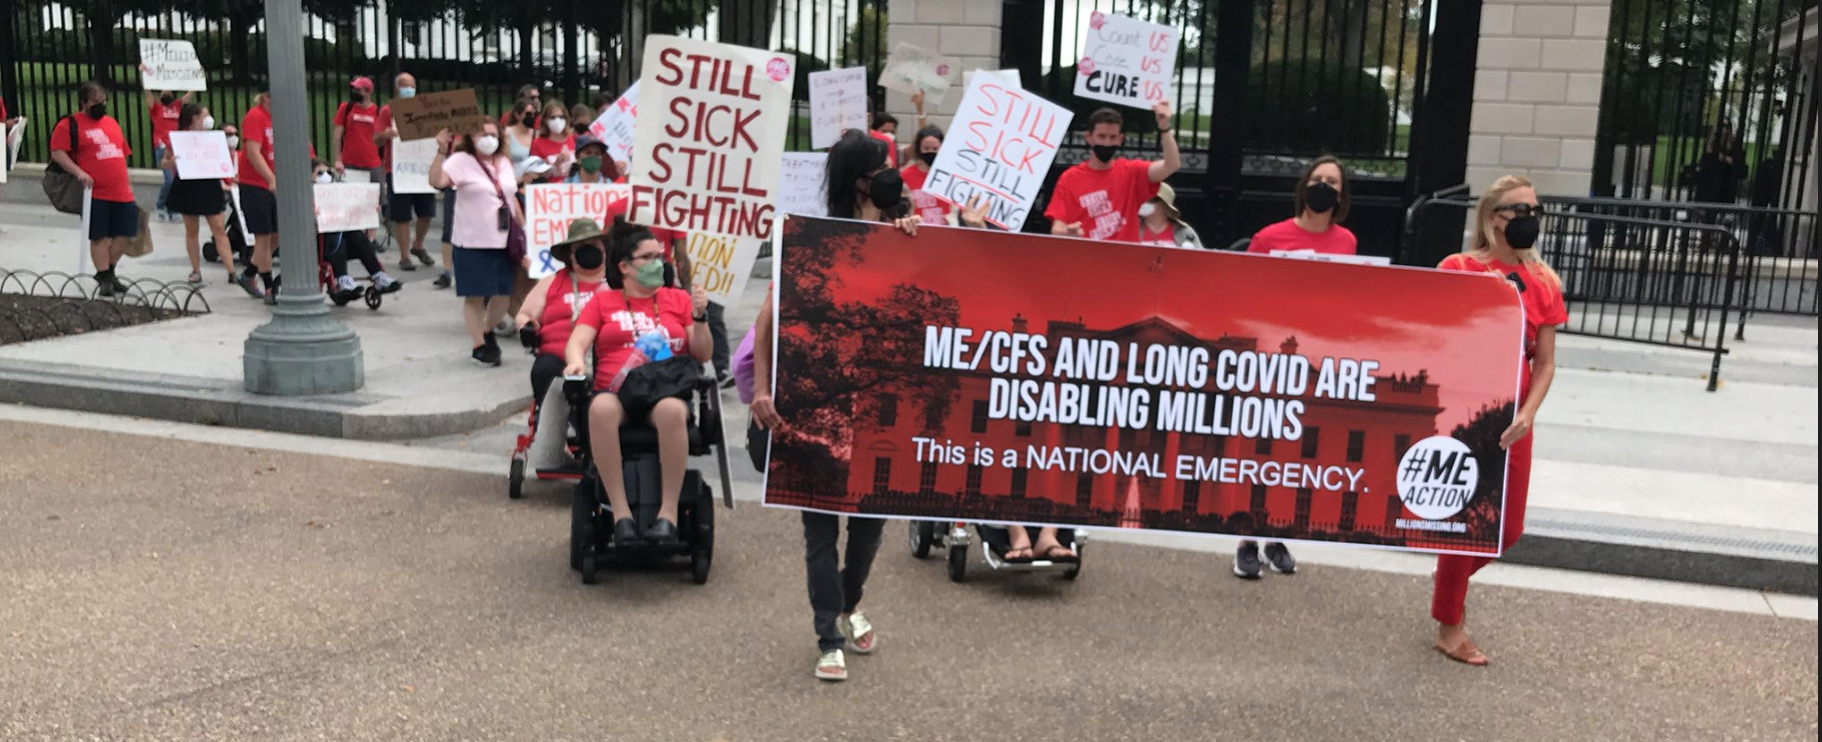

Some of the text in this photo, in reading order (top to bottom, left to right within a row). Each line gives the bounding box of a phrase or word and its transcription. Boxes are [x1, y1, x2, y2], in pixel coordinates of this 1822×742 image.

[1141, 56, 1161, 75] US
[1148, 30, 1171, 53] US
[655, 48, 761, 101] STILL
[1085, 70, 1163, 101] CURE US
[665, 96, 762, 153] SICK
[977, 84, 1056, 149] STILL
[648, 143, 767, 198] STILL
[956, 149, 1027, 200] STILL
[965, 121, 1044, 175] SICK
[629, 185, 775, 240] FIGHTING
[928, 168, 1026, 231] FIGHTING
[924, 325, 1379, 402] ME/CFS AND LONG COVID ARE
[988, 377, 1305, 441] DISABLING MILLIONS
[911, 437, 1370, 493] This is a NATIONAL EMERGENCY.
[1402, 448, 1474, 486] #ME
[1403, 486, 1471, 508] ACTION
